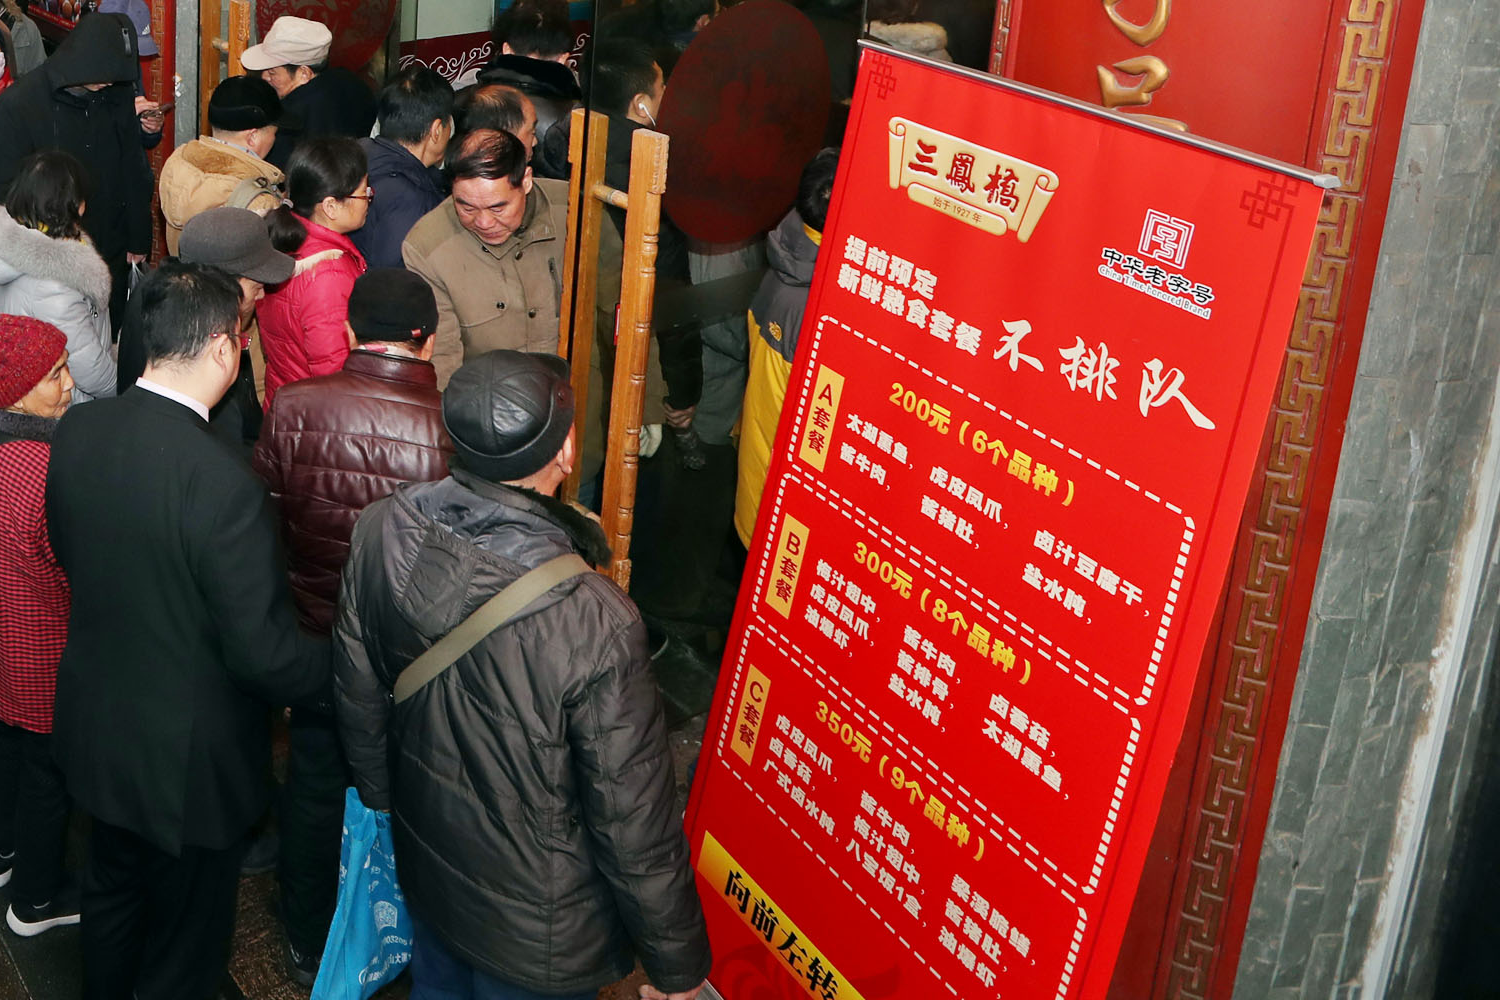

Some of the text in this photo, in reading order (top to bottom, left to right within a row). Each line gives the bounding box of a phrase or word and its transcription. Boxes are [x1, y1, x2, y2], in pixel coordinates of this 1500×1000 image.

[908, 138, 1020, 213] 三鳳橋
[953, 205, 971, 219] 1927
[844, 234, 938, 300] 提前预定
[1099, 265, 1122, 282] China
[1183, 300, 1210, 319] Brand
[1103, 248, 1214, 304] 中华老字号
[837, 263, 982, 356] 新鲜熟食套餐
[993, 318, 1216, 430] 不排队
[808, 383, 833, 454] A套餐
[775, 531, 801, 603] B套餐
[738, 681, 764, 749] C套餐
[724, 869, 839, 1000] 向前左转
